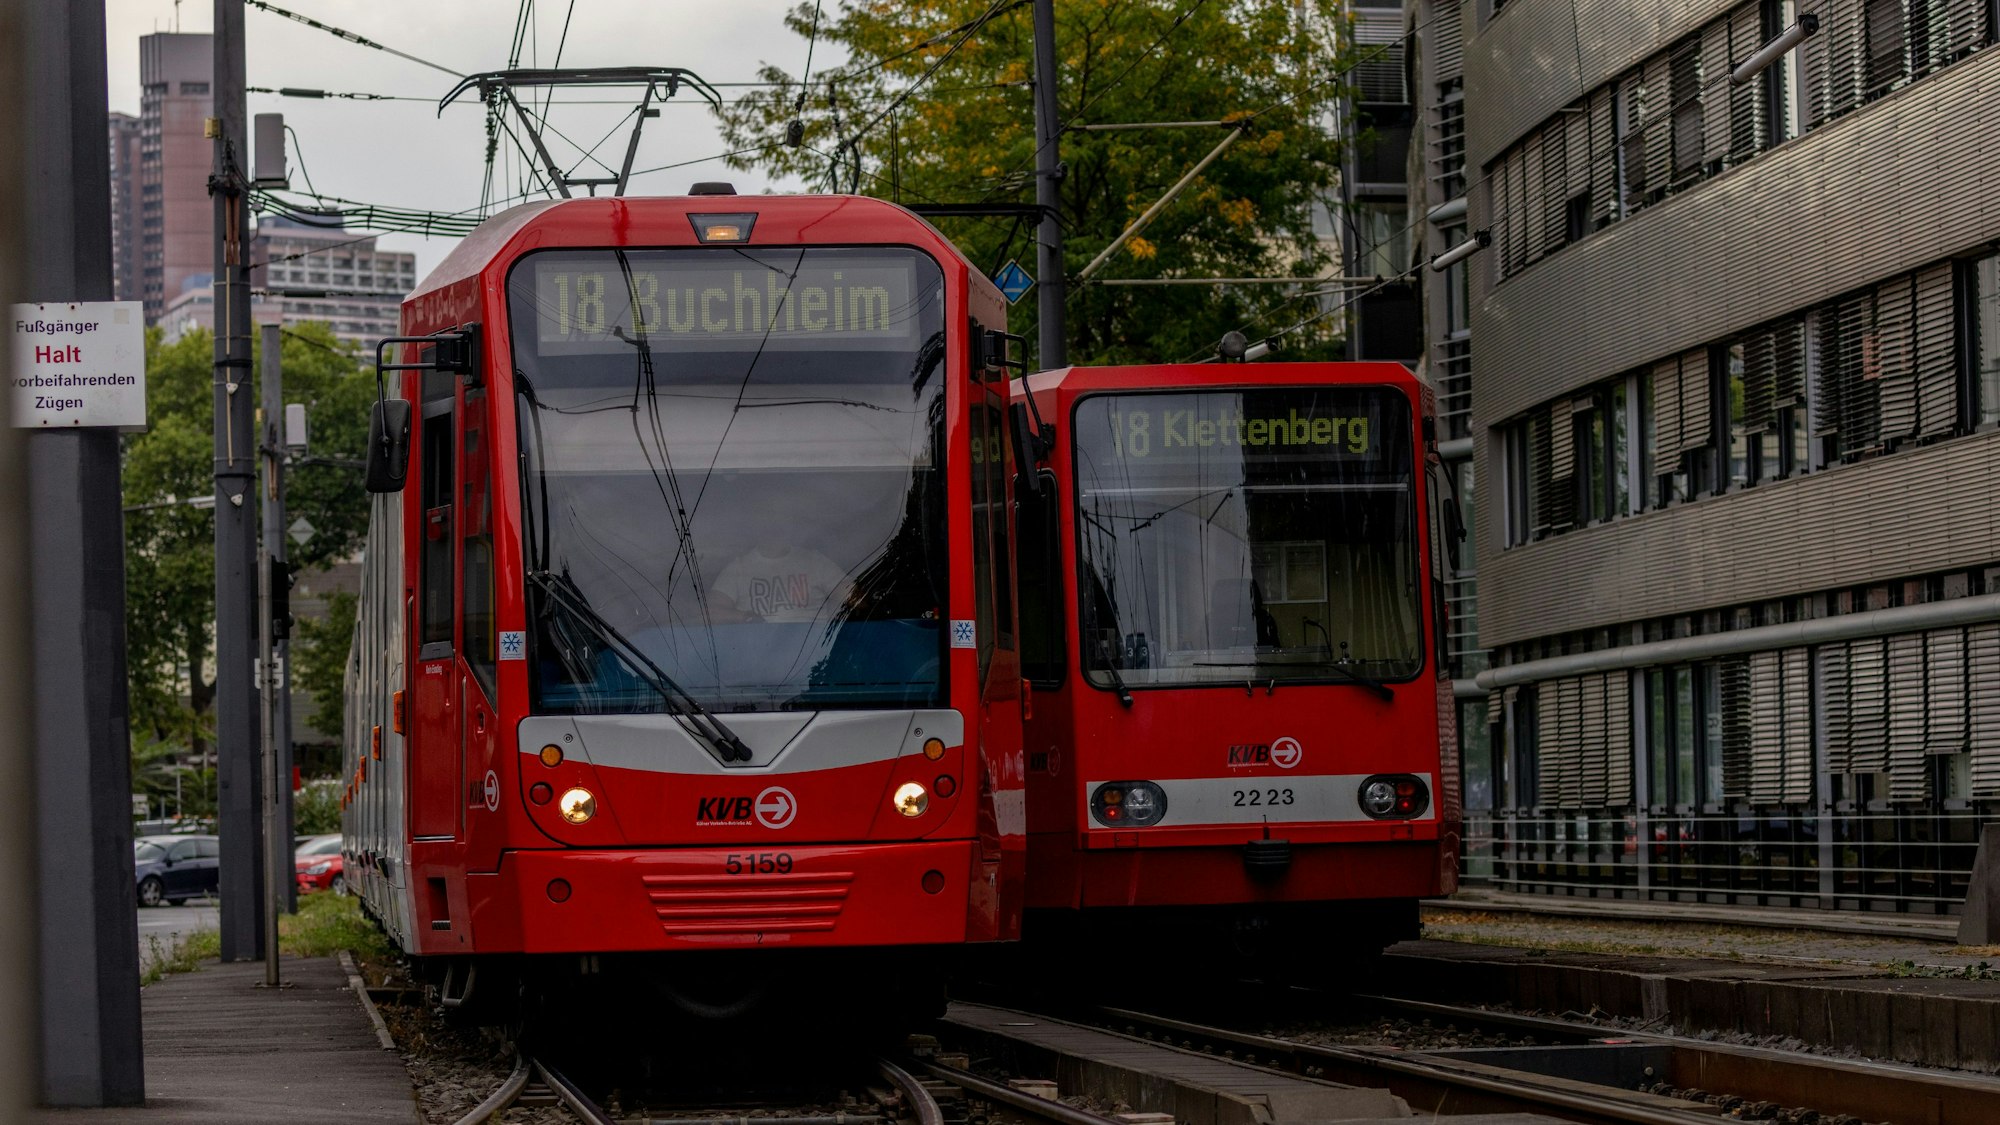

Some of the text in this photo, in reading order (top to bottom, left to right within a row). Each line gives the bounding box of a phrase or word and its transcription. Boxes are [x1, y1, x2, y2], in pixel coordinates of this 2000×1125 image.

[554, 270, 890, 335] 18 Buchheim
[16, 320, 99, 335] Fußgänger
[35, 345, 82, 364] Halt
[35, 396, 83, 412] Zügen
[1112, 407, 1369, 457] 18 Klettenberg
[1228, 744, 1269, 763] KVB
[1233, 788, 1295, 807] 2223
[697, 797, 753, 821] KVB
[725, 853, 793, 875] 5159
